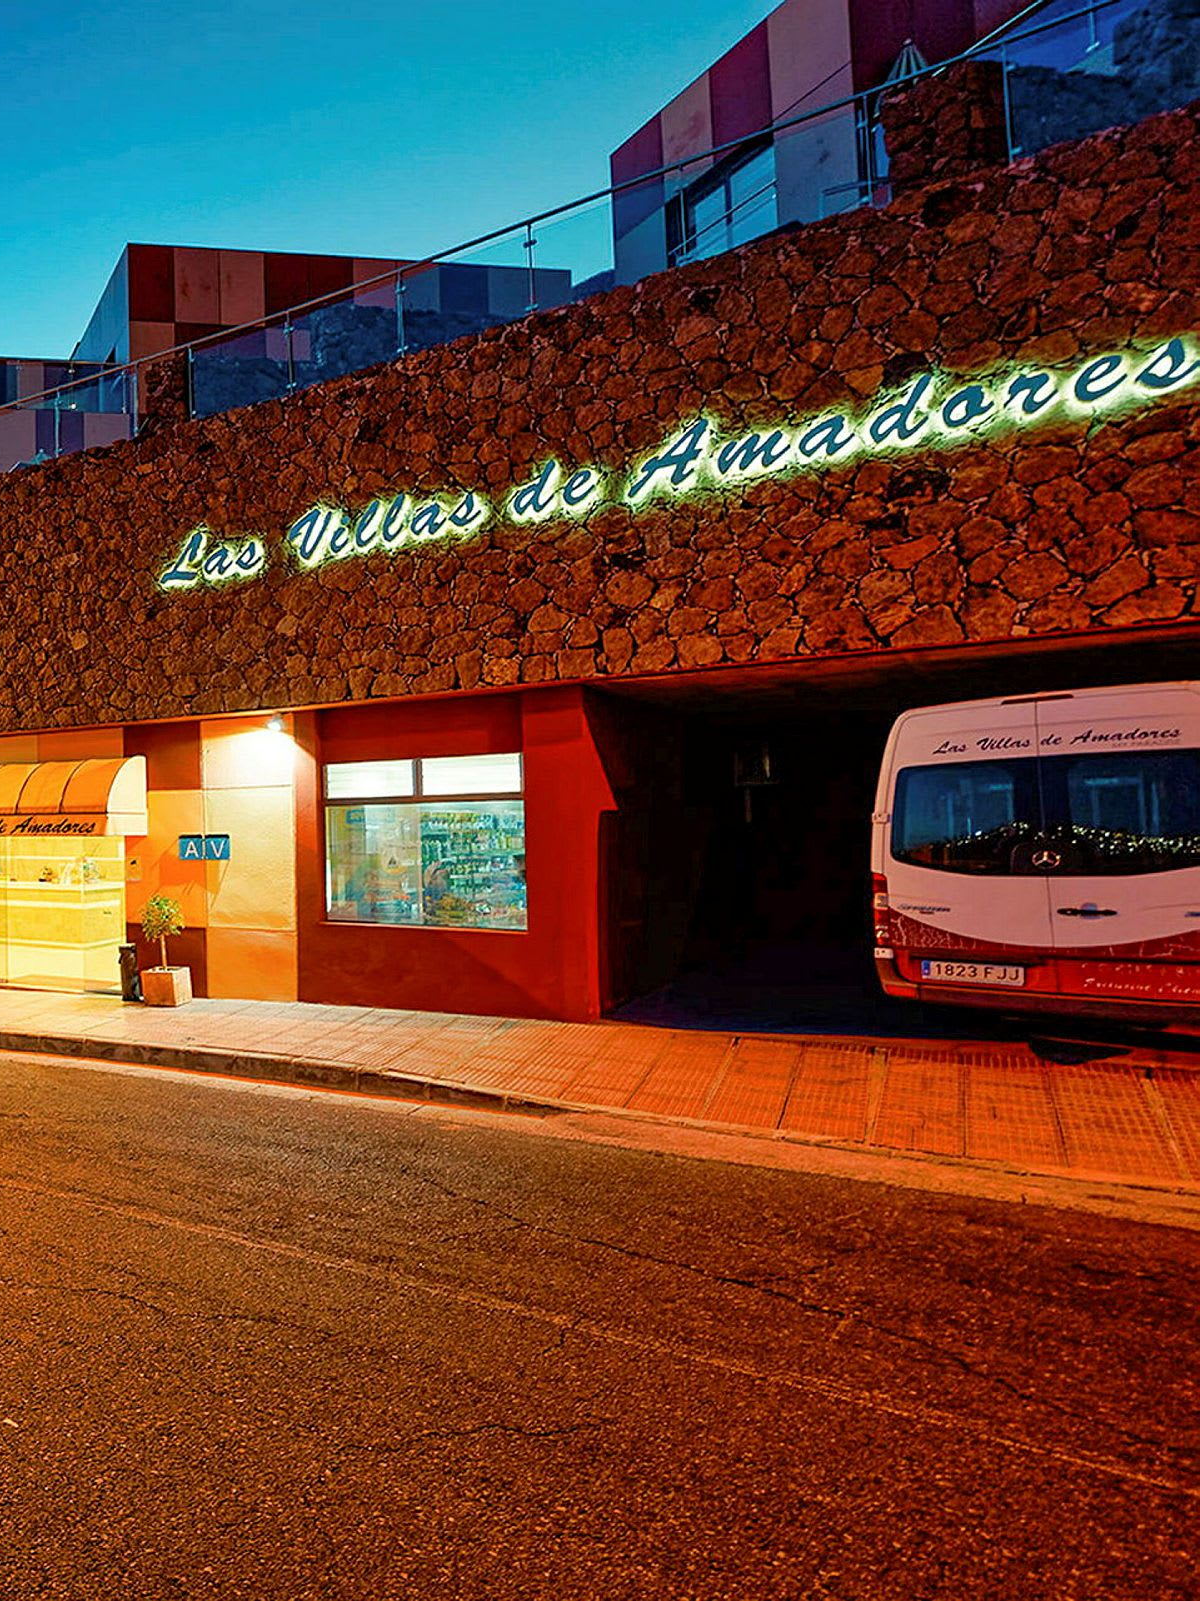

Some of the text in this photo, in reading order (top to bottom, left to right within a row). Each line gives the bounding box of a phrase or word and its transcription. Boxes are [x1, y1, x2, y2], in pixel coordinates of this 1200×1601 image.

[159, 337, 1200, 585] Las Villas de Amadores
[931, 740, 968, 755] Las
[975, 736, 1031, 751] Villas
[1040, 733, 1063, 746] de
[1069, 727, 1182, 745] Amadores
[10, 816, 97, 834] Amadores
[934, 963, 1020, 981] 1823 FJJ
